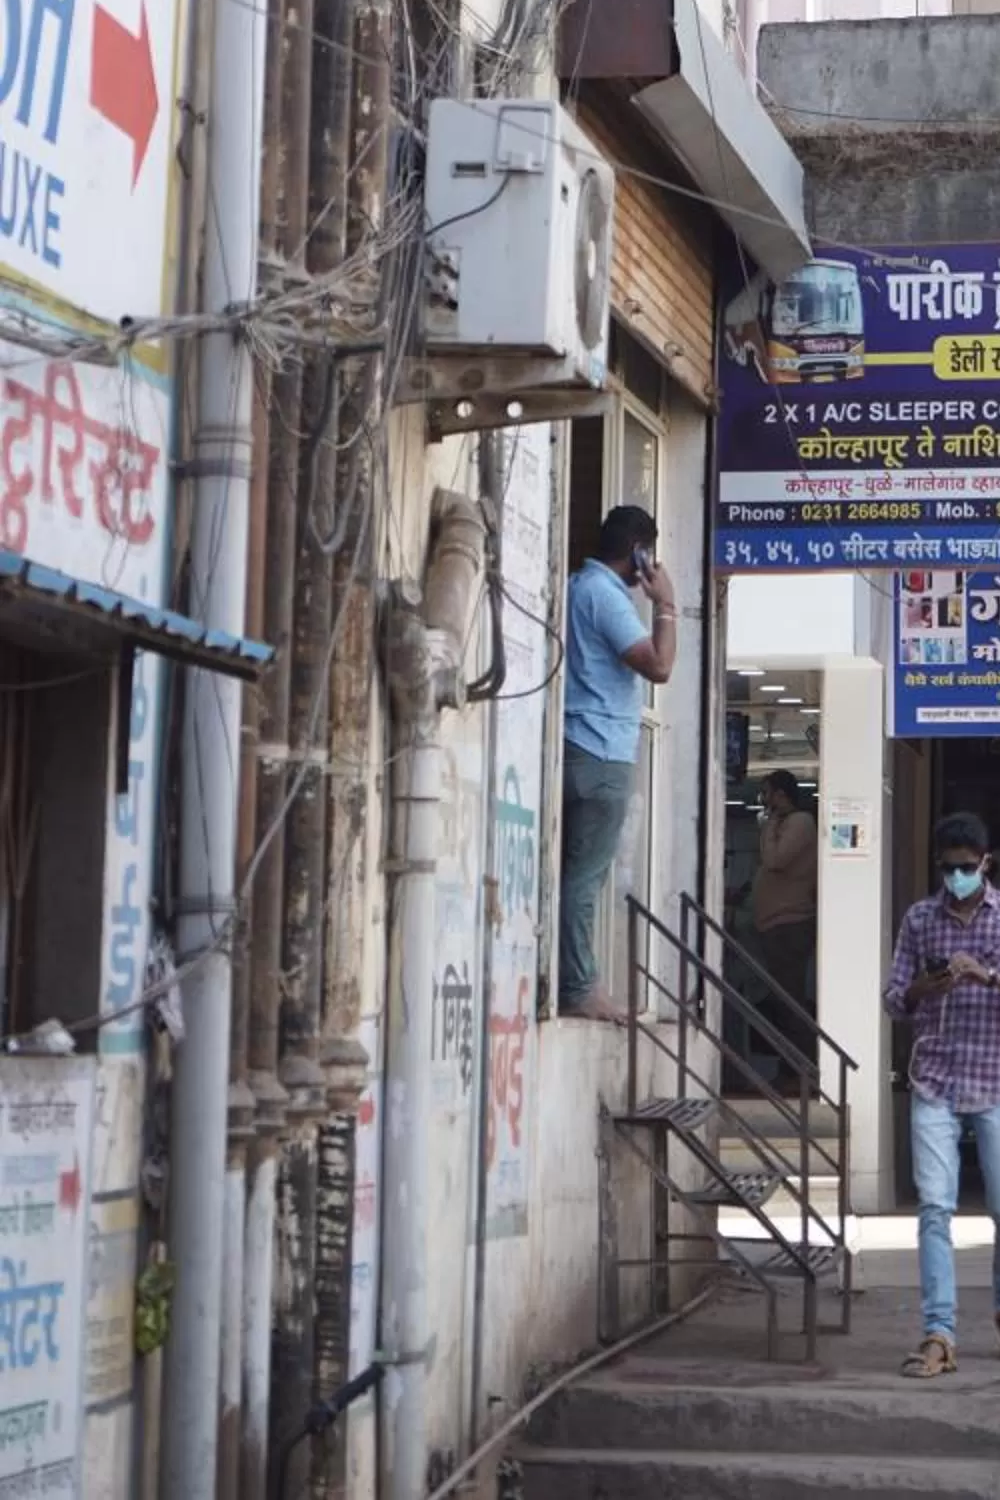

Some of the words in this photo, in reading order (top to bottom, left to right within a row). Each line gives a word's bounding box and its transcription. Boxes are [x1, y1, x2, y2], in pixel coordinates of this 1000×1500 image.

[886, 259, 985, 320] पारीक
[950, 340, 985, 373] डेली
[764, 405, 777, 423] 2
[784, 404, 799, 423] X
[806, 404, 815, 422] 1
[823, 403, 862, 422] A/C
[869, 400, 976, 421] SLEEPER
[797, 428, 910, 468] कोल्हापूर
[916, 426, 936, 458] ते
[729, 505, 785, 521] Phone
[801, 504, 842, 520] 0231
[848, 503, 921, 519] 2664985
[840, 532, 889, 560] सीटर
